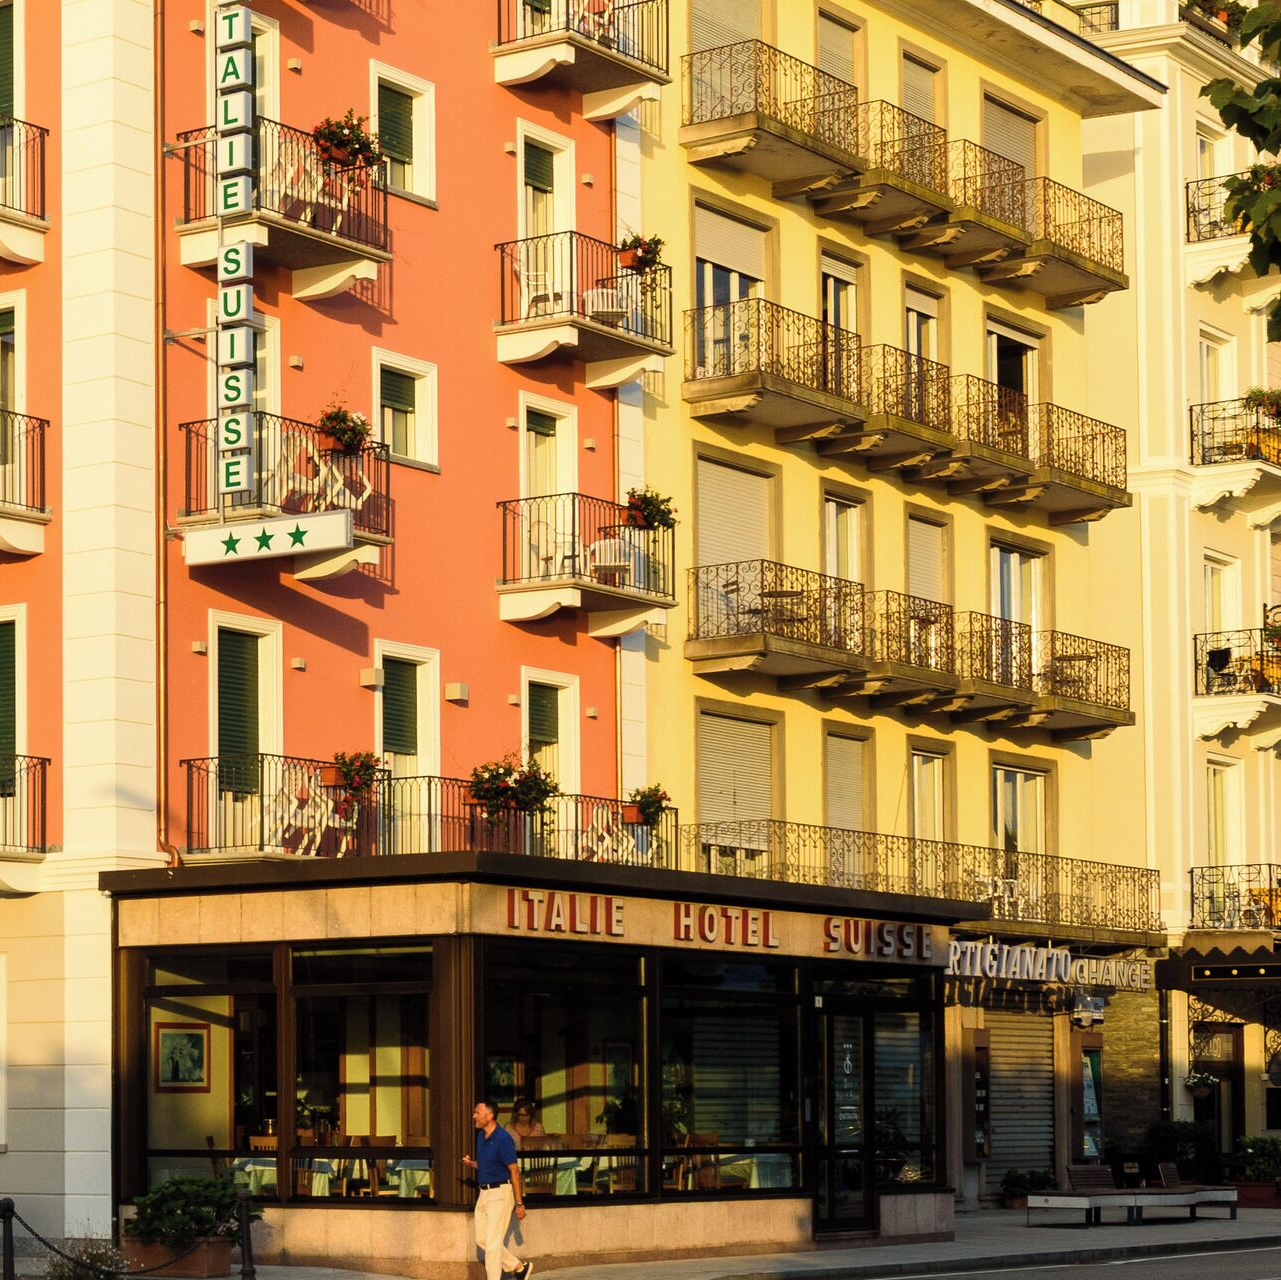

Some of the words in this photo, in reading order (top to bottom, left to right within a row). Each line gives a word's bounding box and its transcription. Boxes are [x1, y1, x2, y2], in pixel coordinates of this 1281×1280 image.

[222, 247, 243, 489] SUISSE
[507, 887, 625, 937] ITALIE
[674, 903, 780, 948] HOTEL
[824, 917, 933, 960] SUISSE
[944, 940, 1072, 983] RTIGIANATO
[1073, 958, 1152, 989] CHANGE
